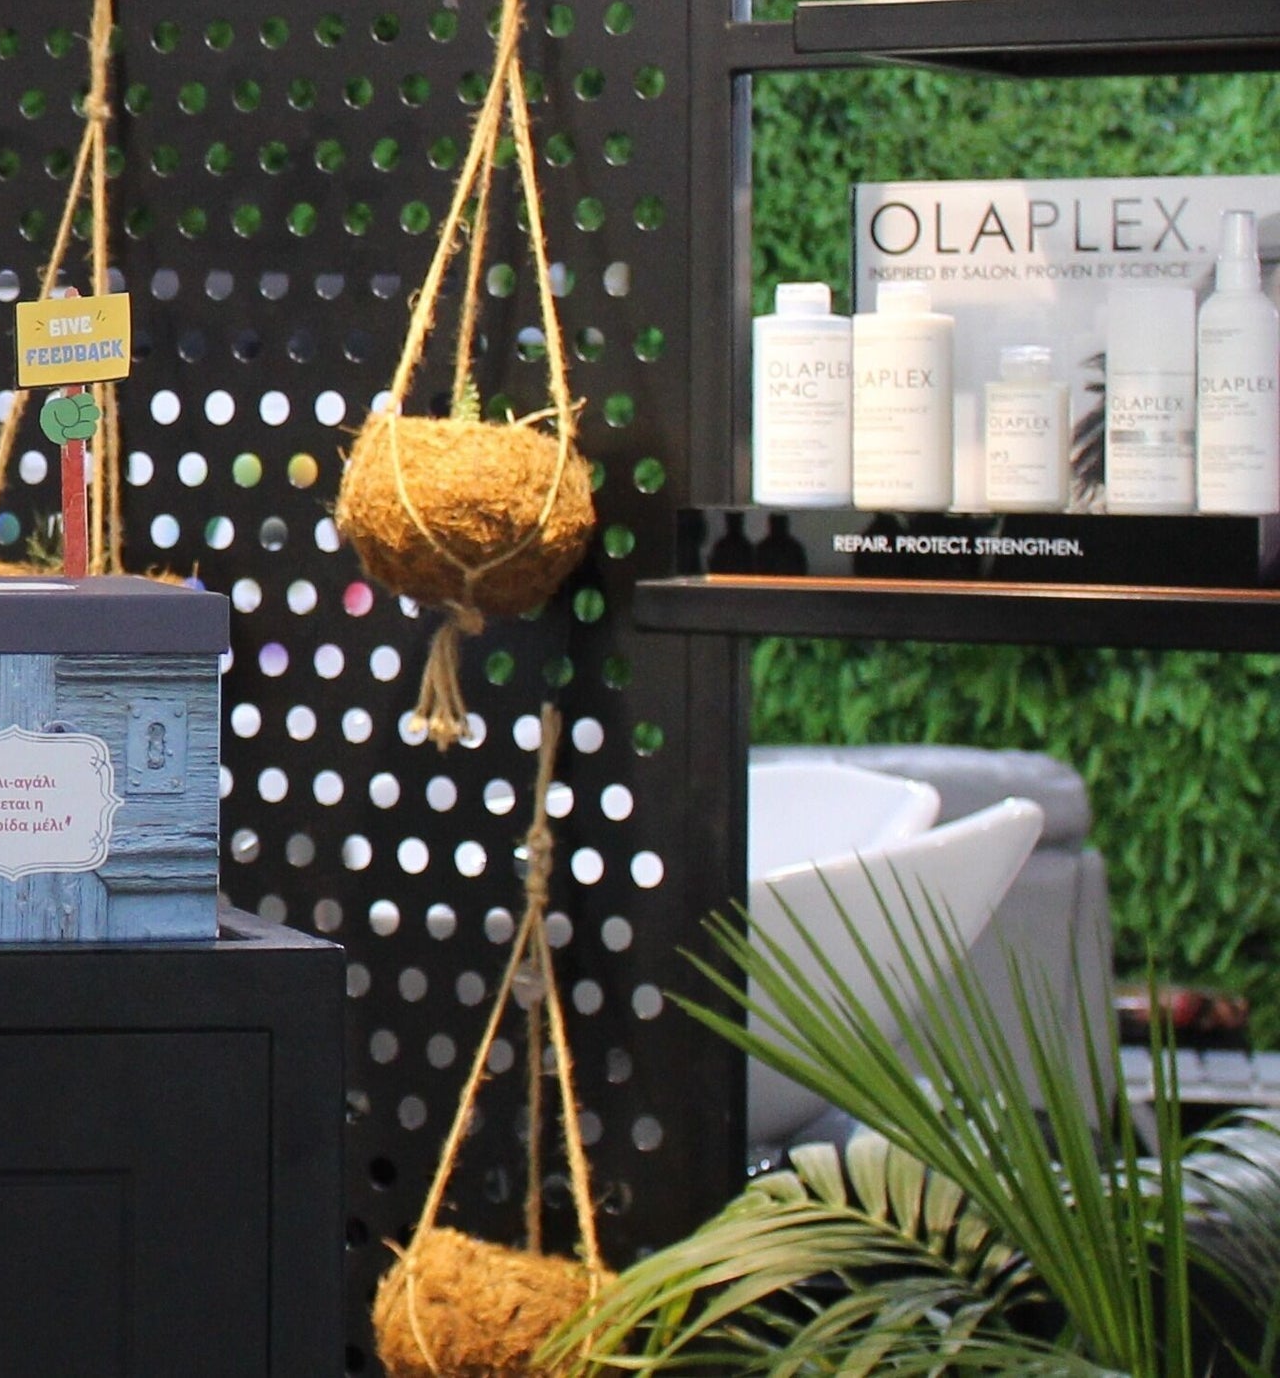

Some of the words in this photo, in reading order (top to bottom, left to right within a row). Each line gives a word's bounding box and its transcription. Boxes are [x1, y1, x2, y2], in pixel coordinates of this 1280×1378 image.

[868, 263, 936, 280] INSPIRED
[940, 264, 960, 279] BY
[1025, 263, 1094, 279] PROVEN
[1097, 263, 1117, 278] BY
[1120, 262, 1189, 278] SCIENCE
[49, 316, 93, 337] GIVE
[26, 339, 124, 366] FEEDBACK
[768, 361, 851, 379] OLAPLE
[833, 534, 893, 553] REPAIR.
[895, 536, 972, 554] PROTECT.
[974, 537, 1085, 557] STRENGTHEN.
[34, 800, 44, 813] η
